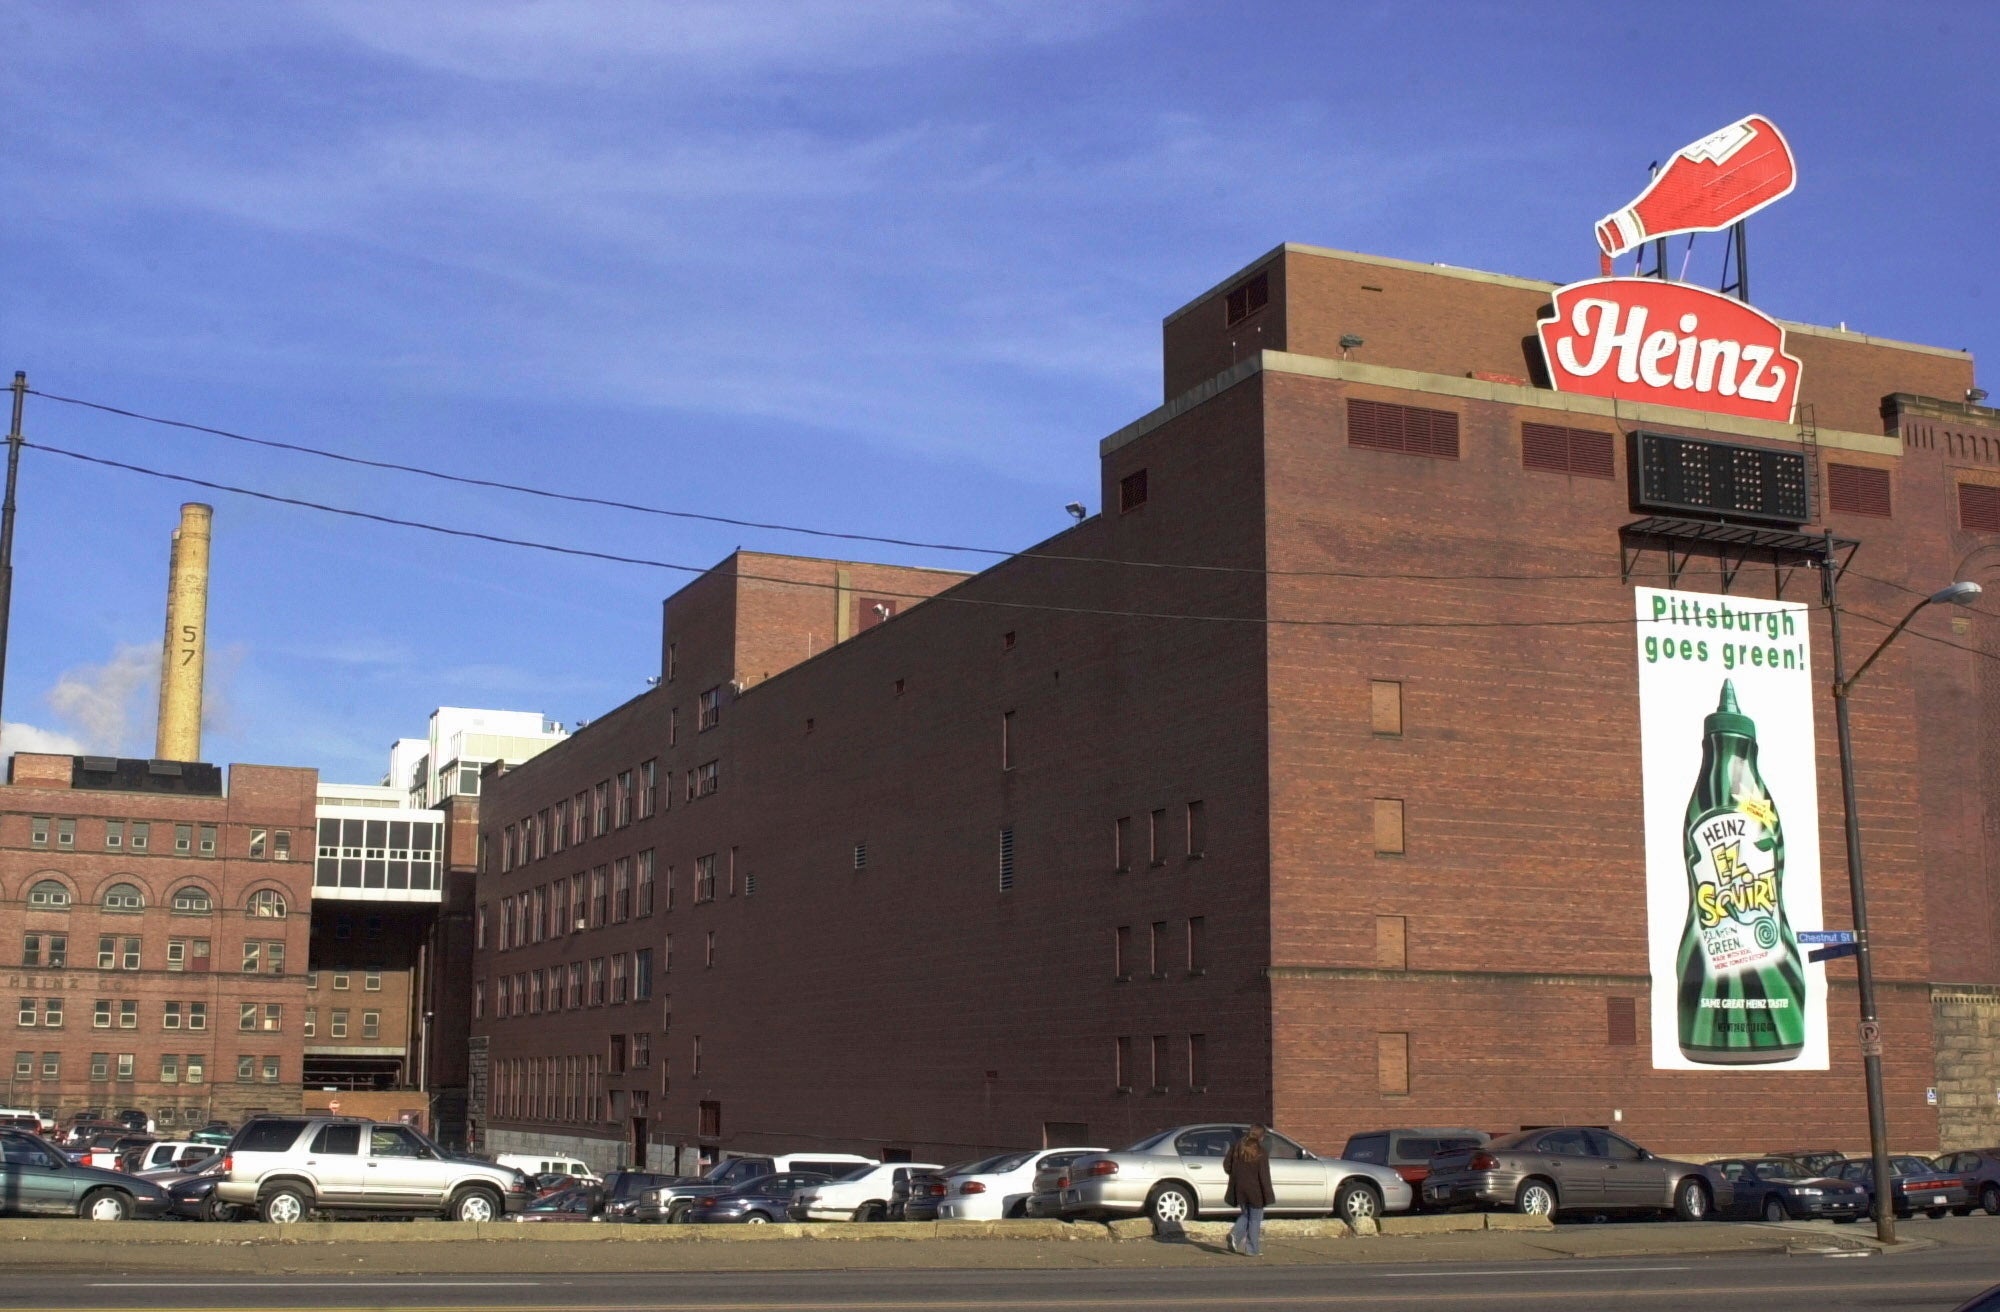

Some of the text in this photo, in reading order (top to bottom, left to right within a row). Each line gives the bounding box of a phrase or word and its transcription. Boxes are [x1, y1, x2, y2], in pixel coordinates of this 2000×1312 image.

[1557, 297, 1787, 403] Heinz
[1652, 595, 1794, 640] Pittsburgh
[1645, 636, 1804, 670] goes green!
[1702, 819, 1746, 846] HEINZ
[1711, 840, 1749, 886] EZ
[1799, 933, 1851, 942] Chestnut St
[1700, 998, 1721, 1008] SAME
[1721, 999, 1745, 1009] GREAT
